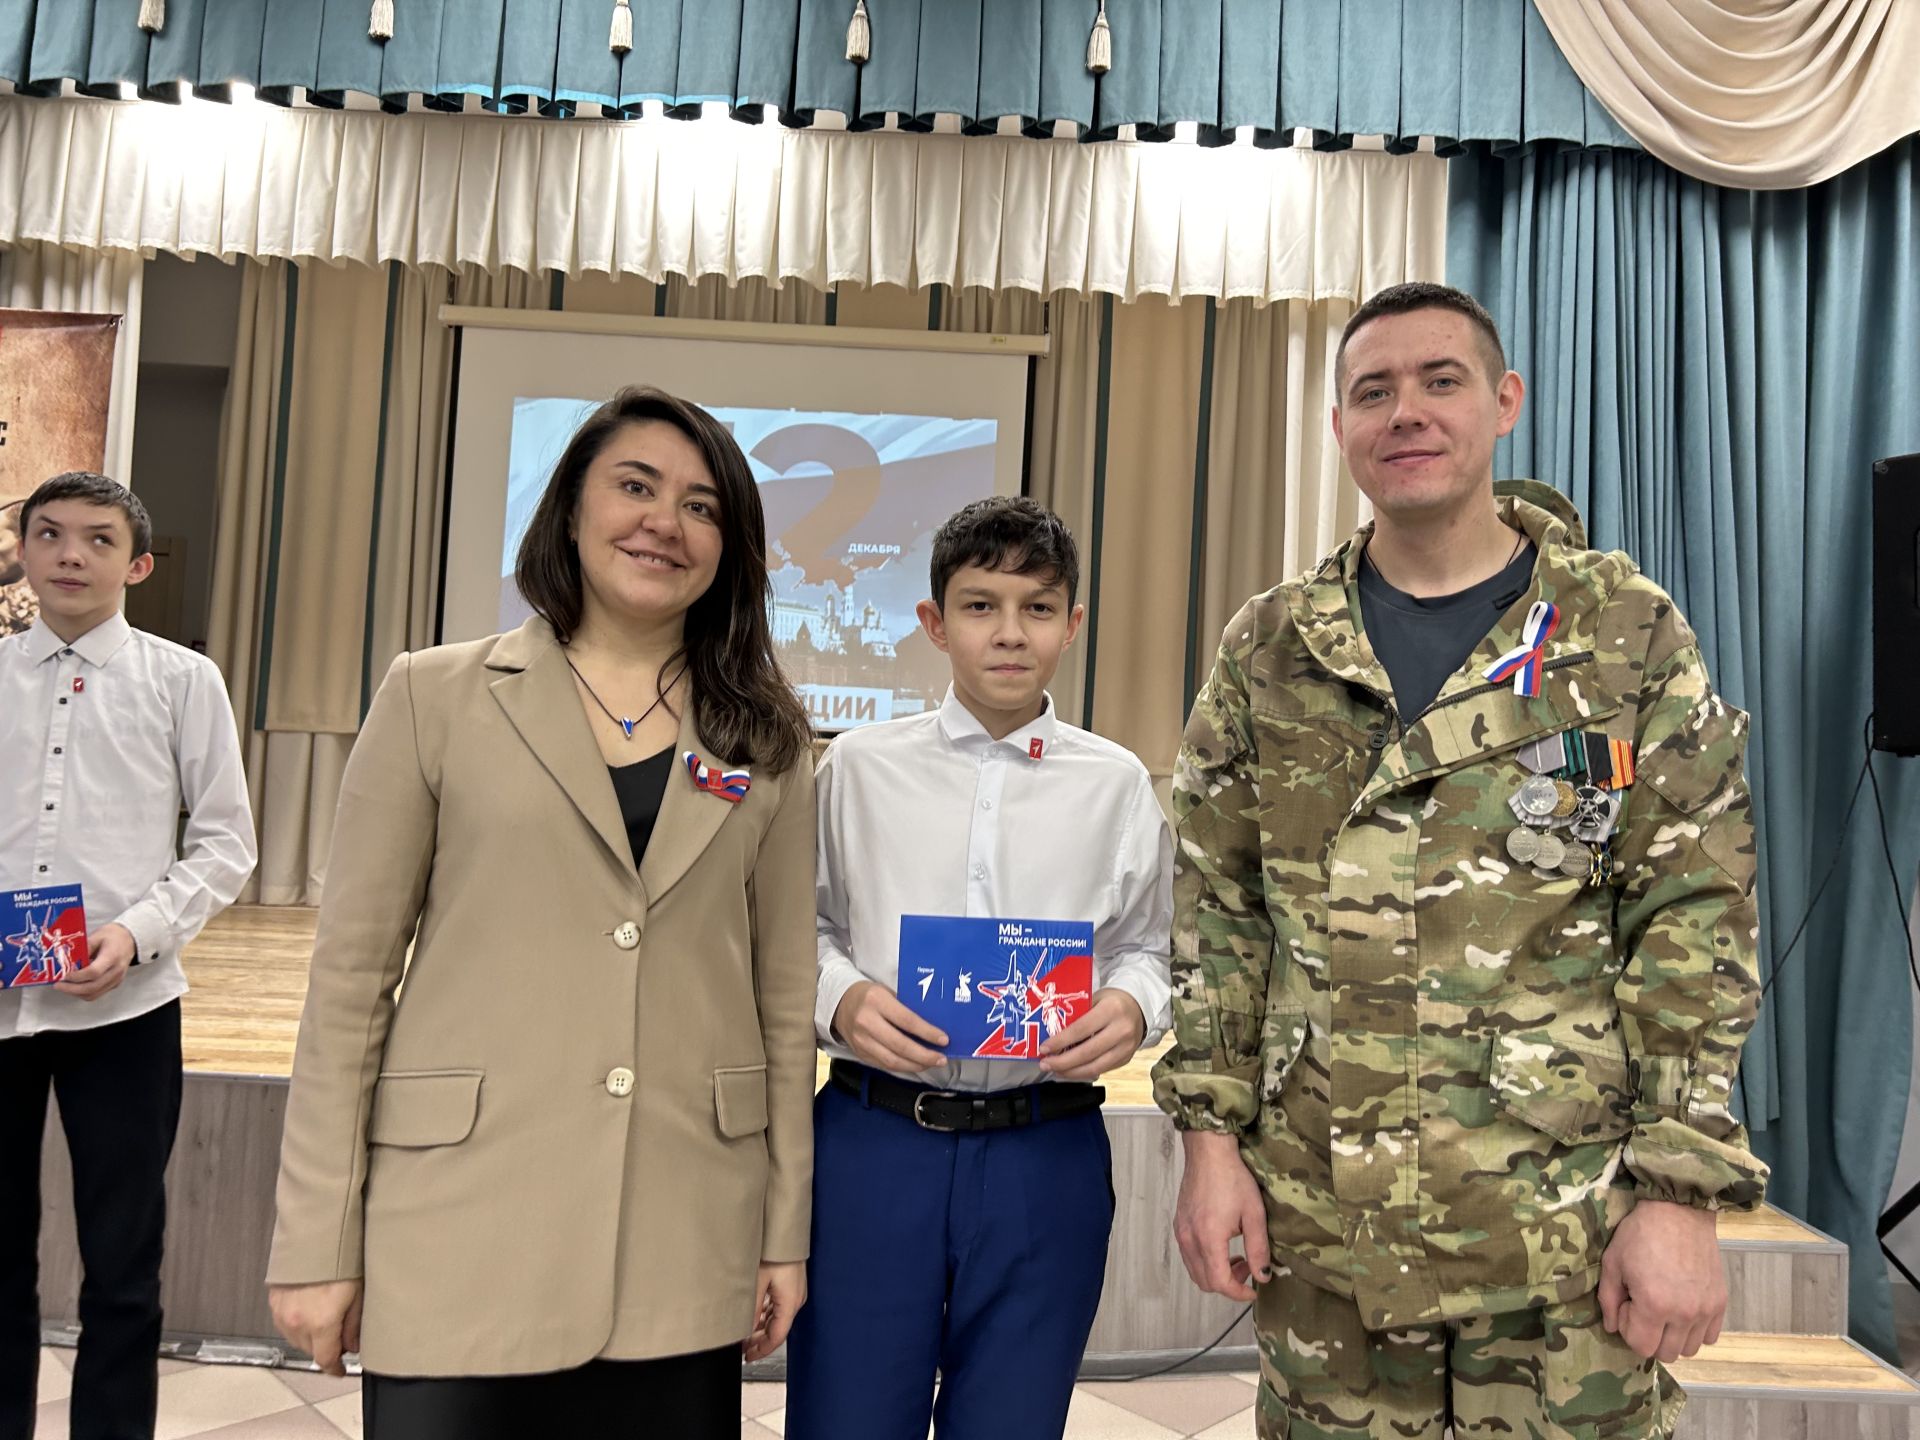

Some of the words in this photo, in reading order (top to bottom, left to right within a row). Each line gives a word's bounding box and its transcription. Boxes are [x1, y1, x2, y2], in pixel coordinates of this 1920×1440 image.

[848, 543, 901, 554] ДЕКАБРЯ
[800, 694, 877, 722] ЦИИ
[998, 923, 1022, 936] МЫ
[998, 936, 1047, 947] ГРАЖДАНЕ
[1047, 938, 1087, 948] РОССИИ!
